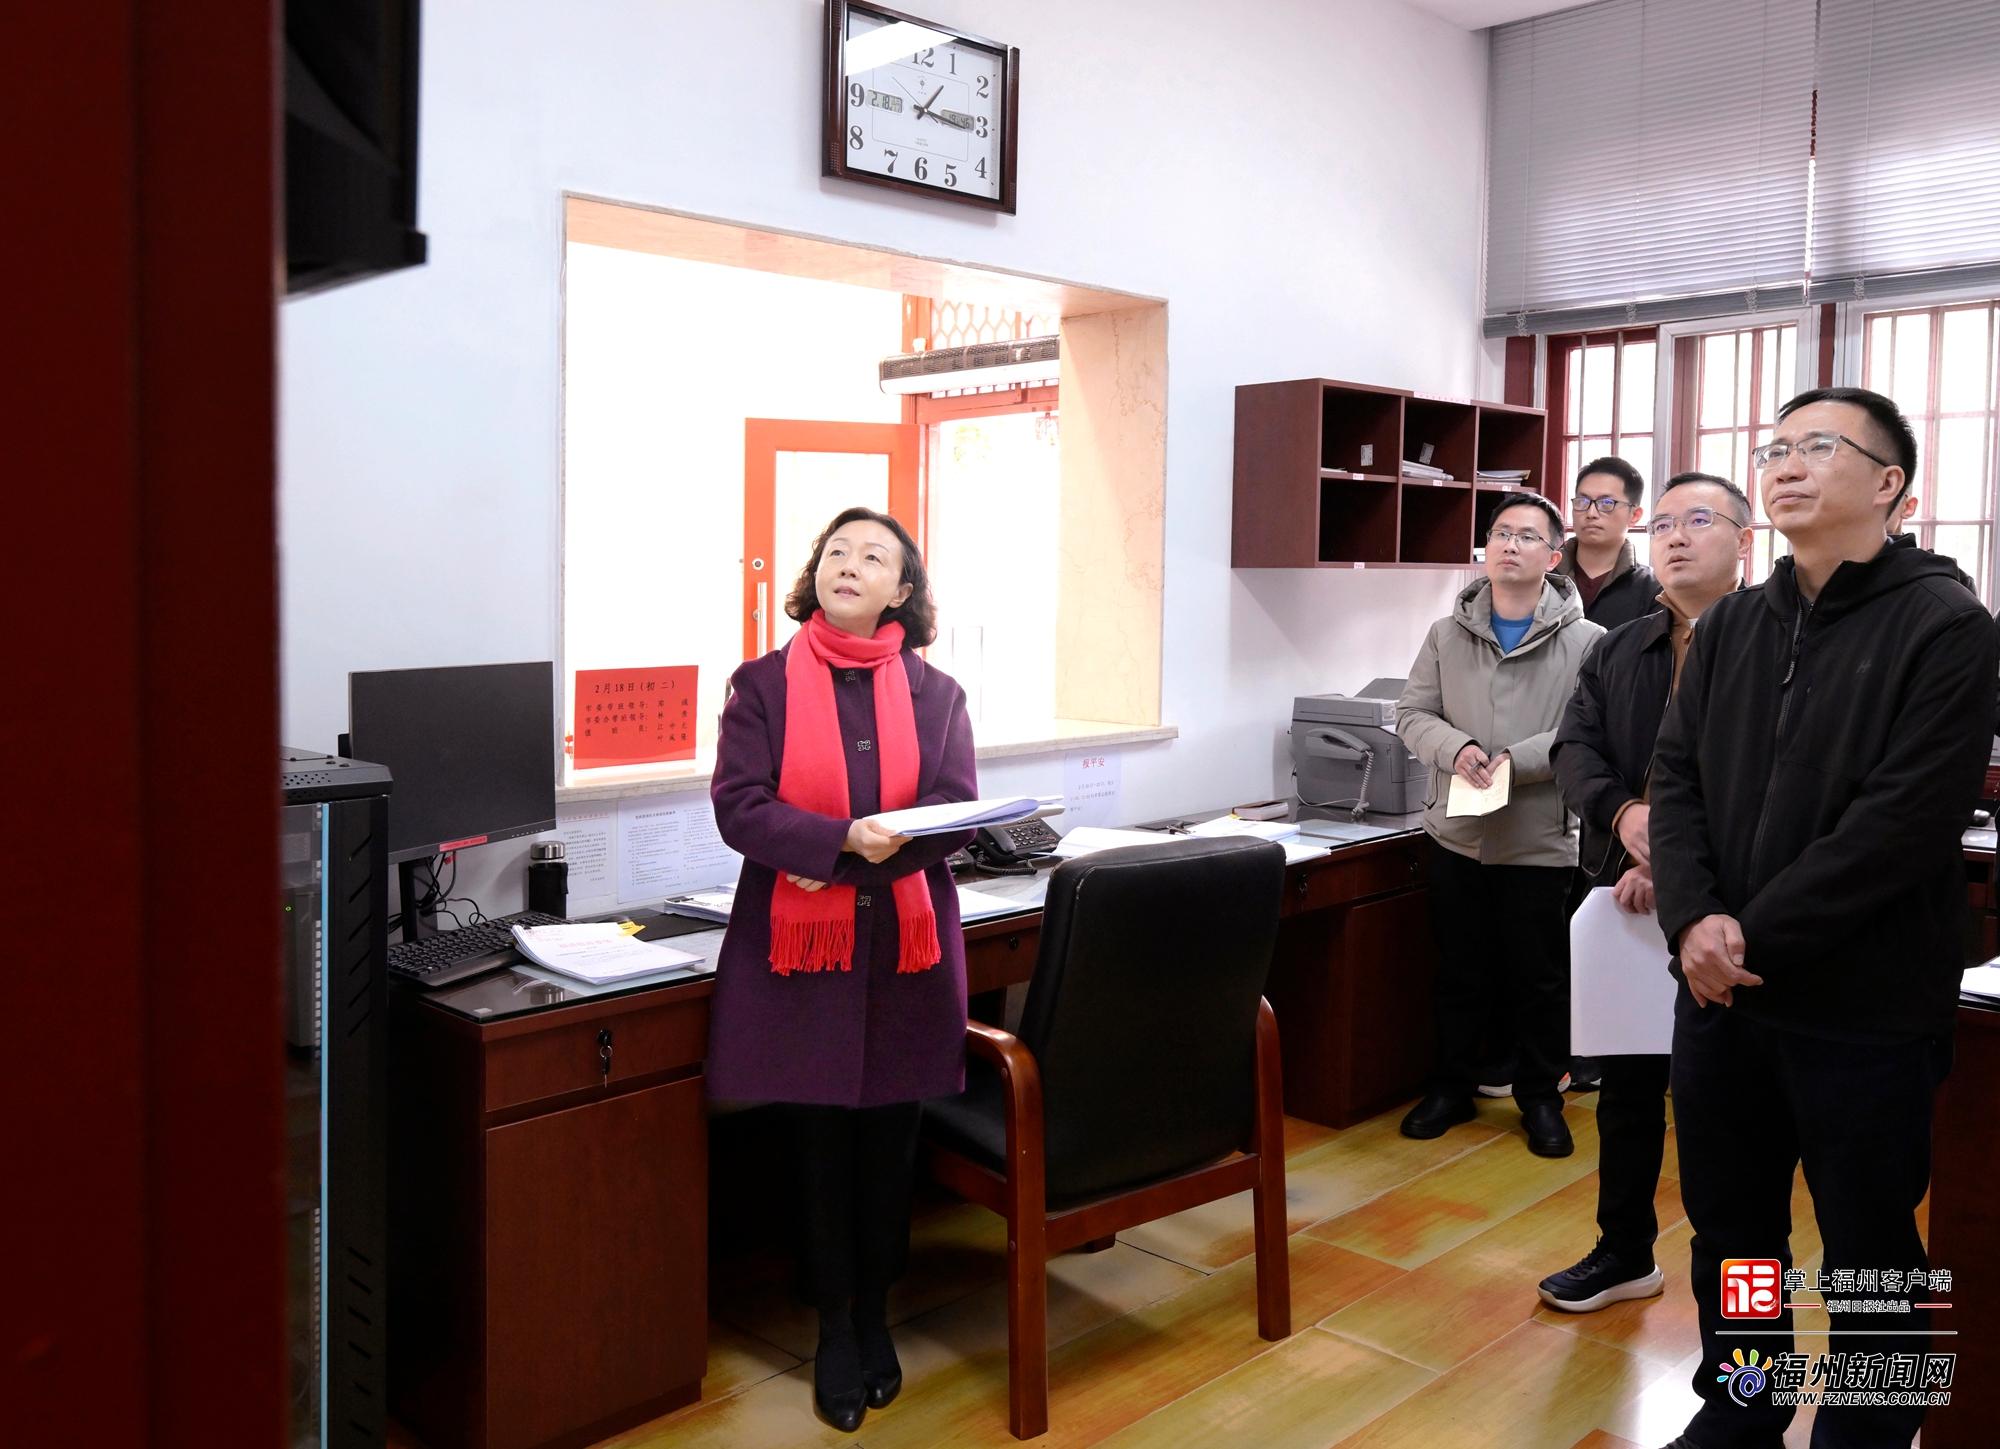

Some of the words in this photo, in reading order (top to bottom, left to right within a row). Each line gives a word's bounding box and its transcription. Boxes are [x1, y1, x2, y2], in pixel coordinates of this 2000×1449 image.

[912, 47, 935, 68] 12
[949, 53, 957, 75] 1
[850, 83, 865, 107] 9
[976, 75, 989, 99] 2
[850, 126, 864, 150] 8
[976, 116, 988, 138] 3
[884, 149, 898, 173] 7
[914, 157, 928, 180] 6
[975, 157, 987, 178] 4
[944, 164, 957, 187] 5
